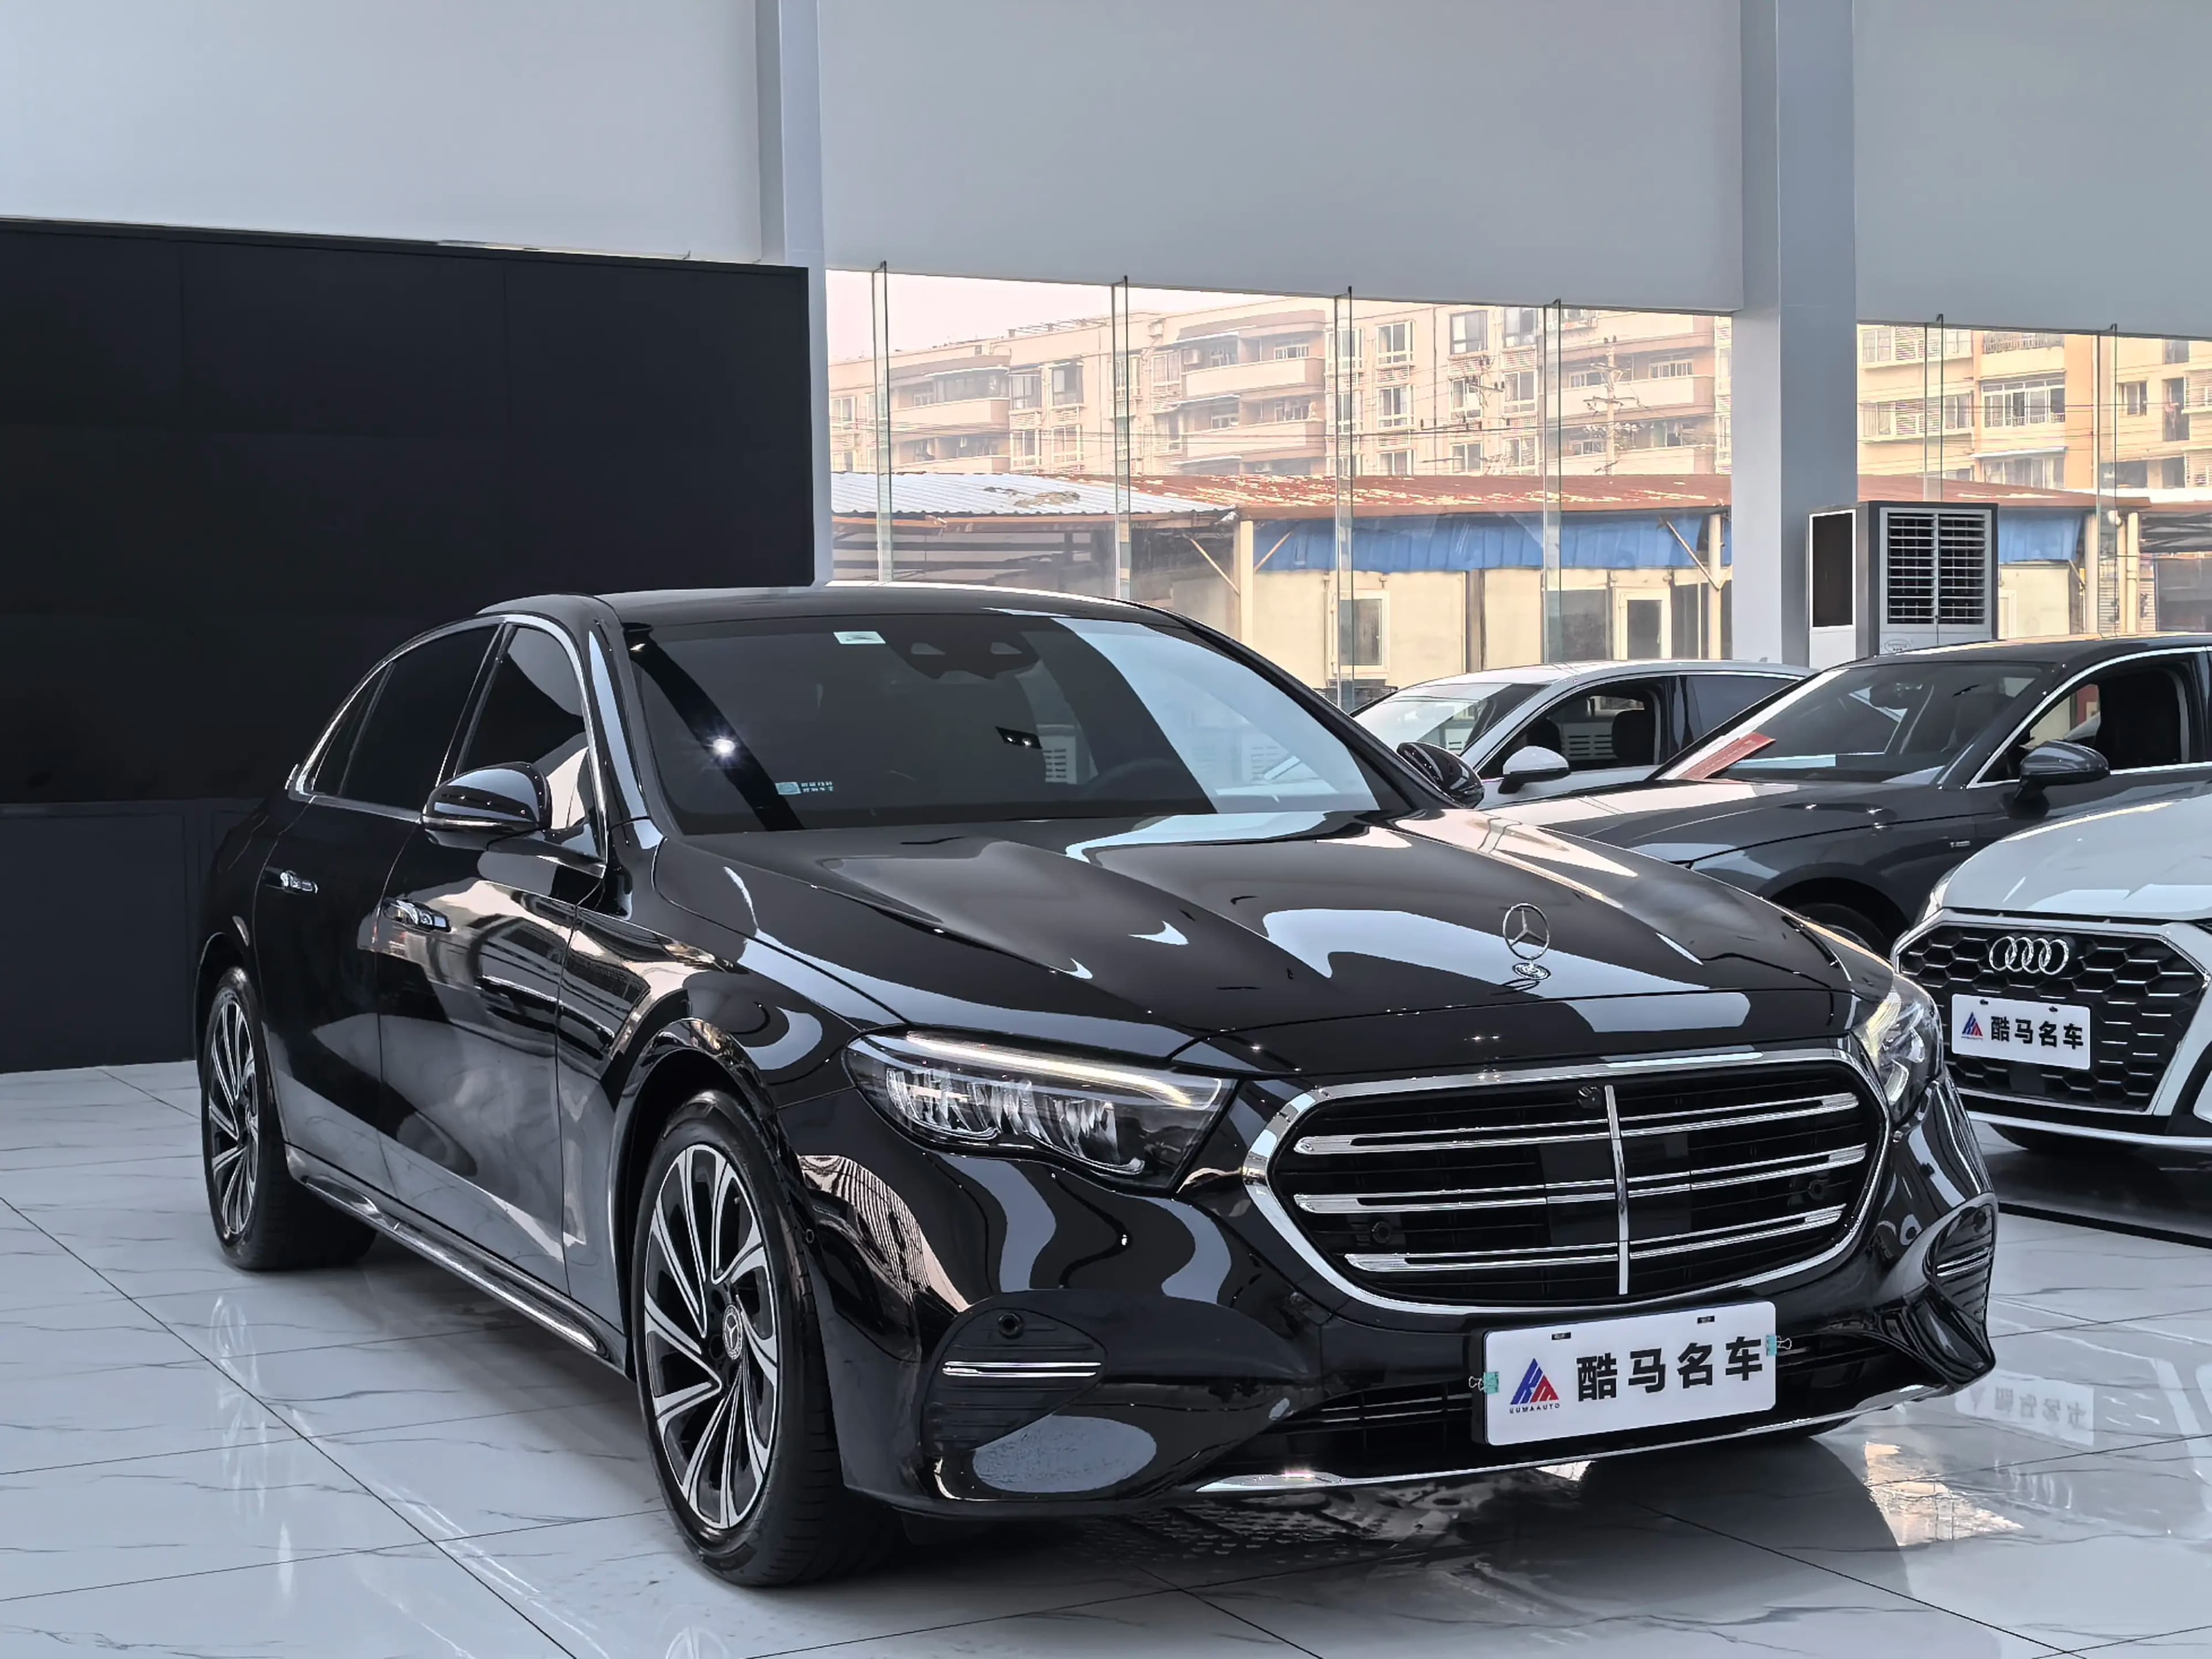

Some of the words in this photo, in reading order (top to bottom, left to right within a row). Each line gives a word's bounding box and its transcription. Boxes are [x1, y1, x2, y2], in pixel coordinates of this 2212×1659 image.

[1990, 1016, 2084, 1050] 酷马名车
[1576, 1336, 1763, 1402] 酷马名车
